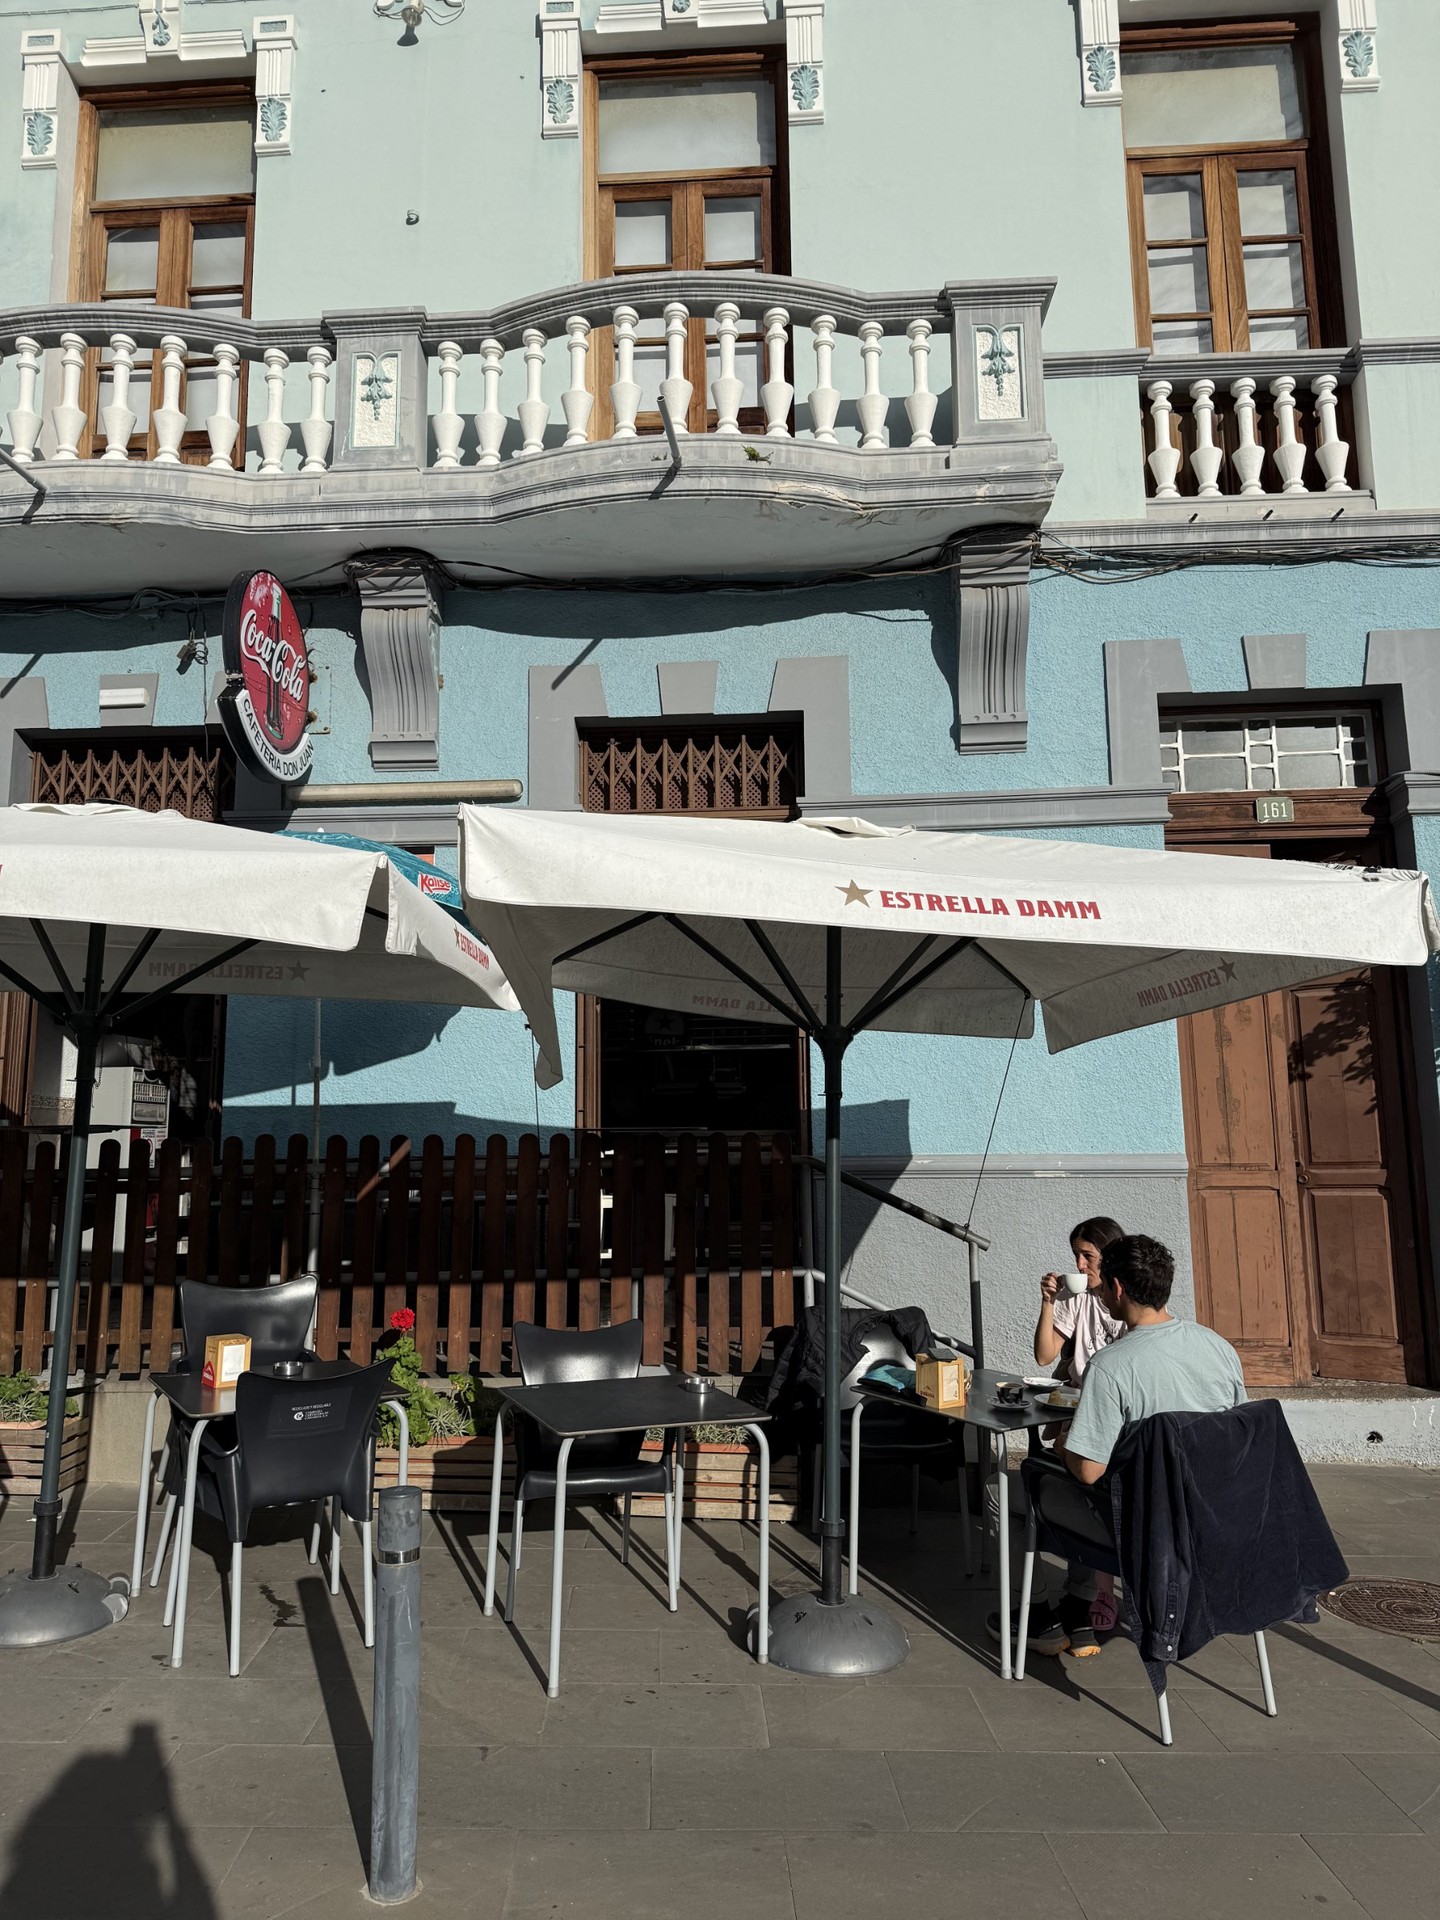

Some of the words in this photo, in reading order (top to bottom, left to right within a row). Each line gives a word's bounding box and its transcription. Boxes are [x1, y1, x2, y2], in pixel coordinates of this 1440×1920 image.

[240, 609, 306, 702] Coca-Cola
[243, 698, 282, 773] CAFETERIA
[283, 760, 298, 776] DON
[299, 740, 315, 771] JUAN
[1263, 802, 1288, 818] 161
[879, 889, 1010, 916] ESTRELLA
[1015, 898, 1102, 920] DAMM
